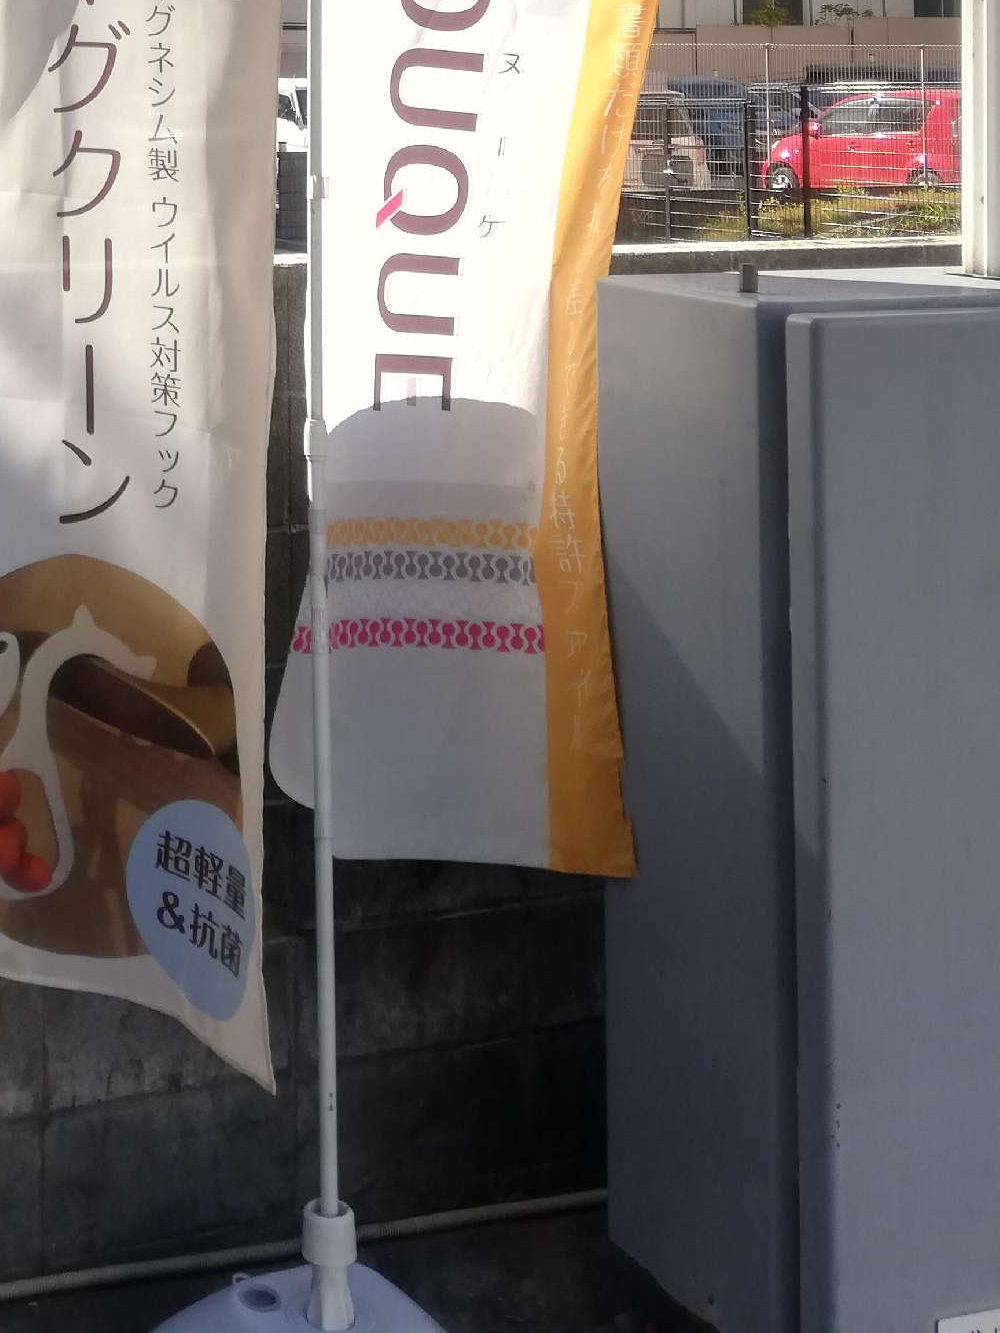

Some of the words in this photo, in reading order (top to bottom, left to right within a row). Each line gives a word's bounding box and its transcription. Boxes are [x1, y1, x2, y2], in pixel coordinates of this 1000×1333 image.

[477, 52, 522, 239] ヌーケ
[149, 195, 182, 509] ウイルス対策フック
[155, 830, 245, 921] 超軽量
[156, 891, 243, 979] &抗菌
